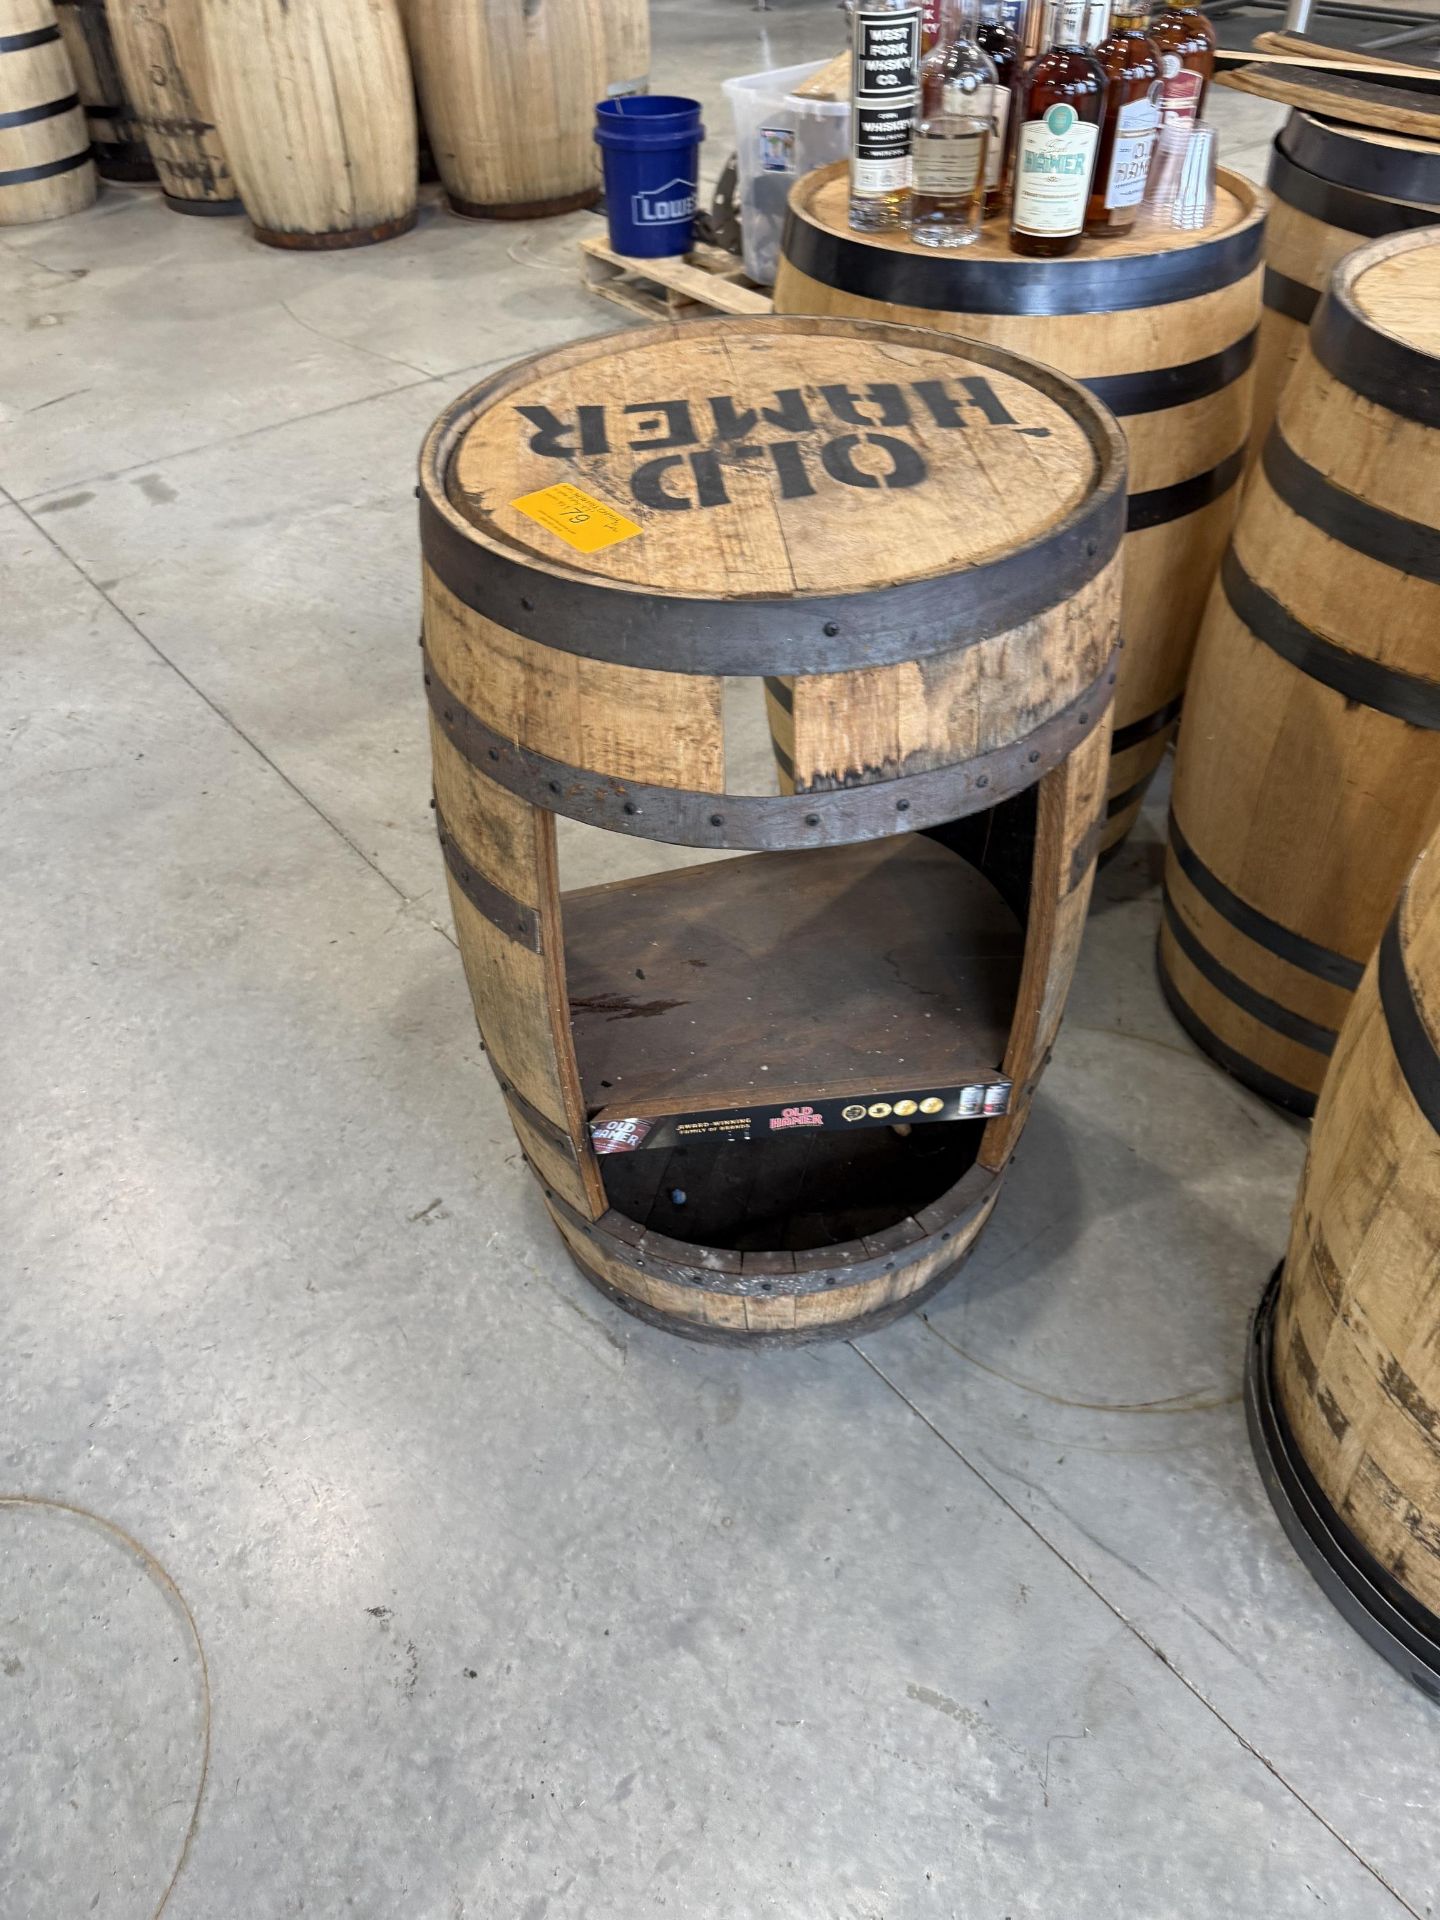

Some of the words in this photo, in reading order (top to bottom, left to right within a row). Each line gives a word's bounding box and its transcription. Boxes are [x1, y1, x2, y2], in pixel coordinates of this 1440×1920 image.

[869, 27, 910, 41] WEST
[869, 42, 908, 56] FORK
[875, 74, 901, 86] CO.
[514, 375, 1019, 459] HAMER
[629, 431, 929, 511] OLD
[782, 1105, 814, 1117] OLD
[606, 1121, 636, 1133] OLD
